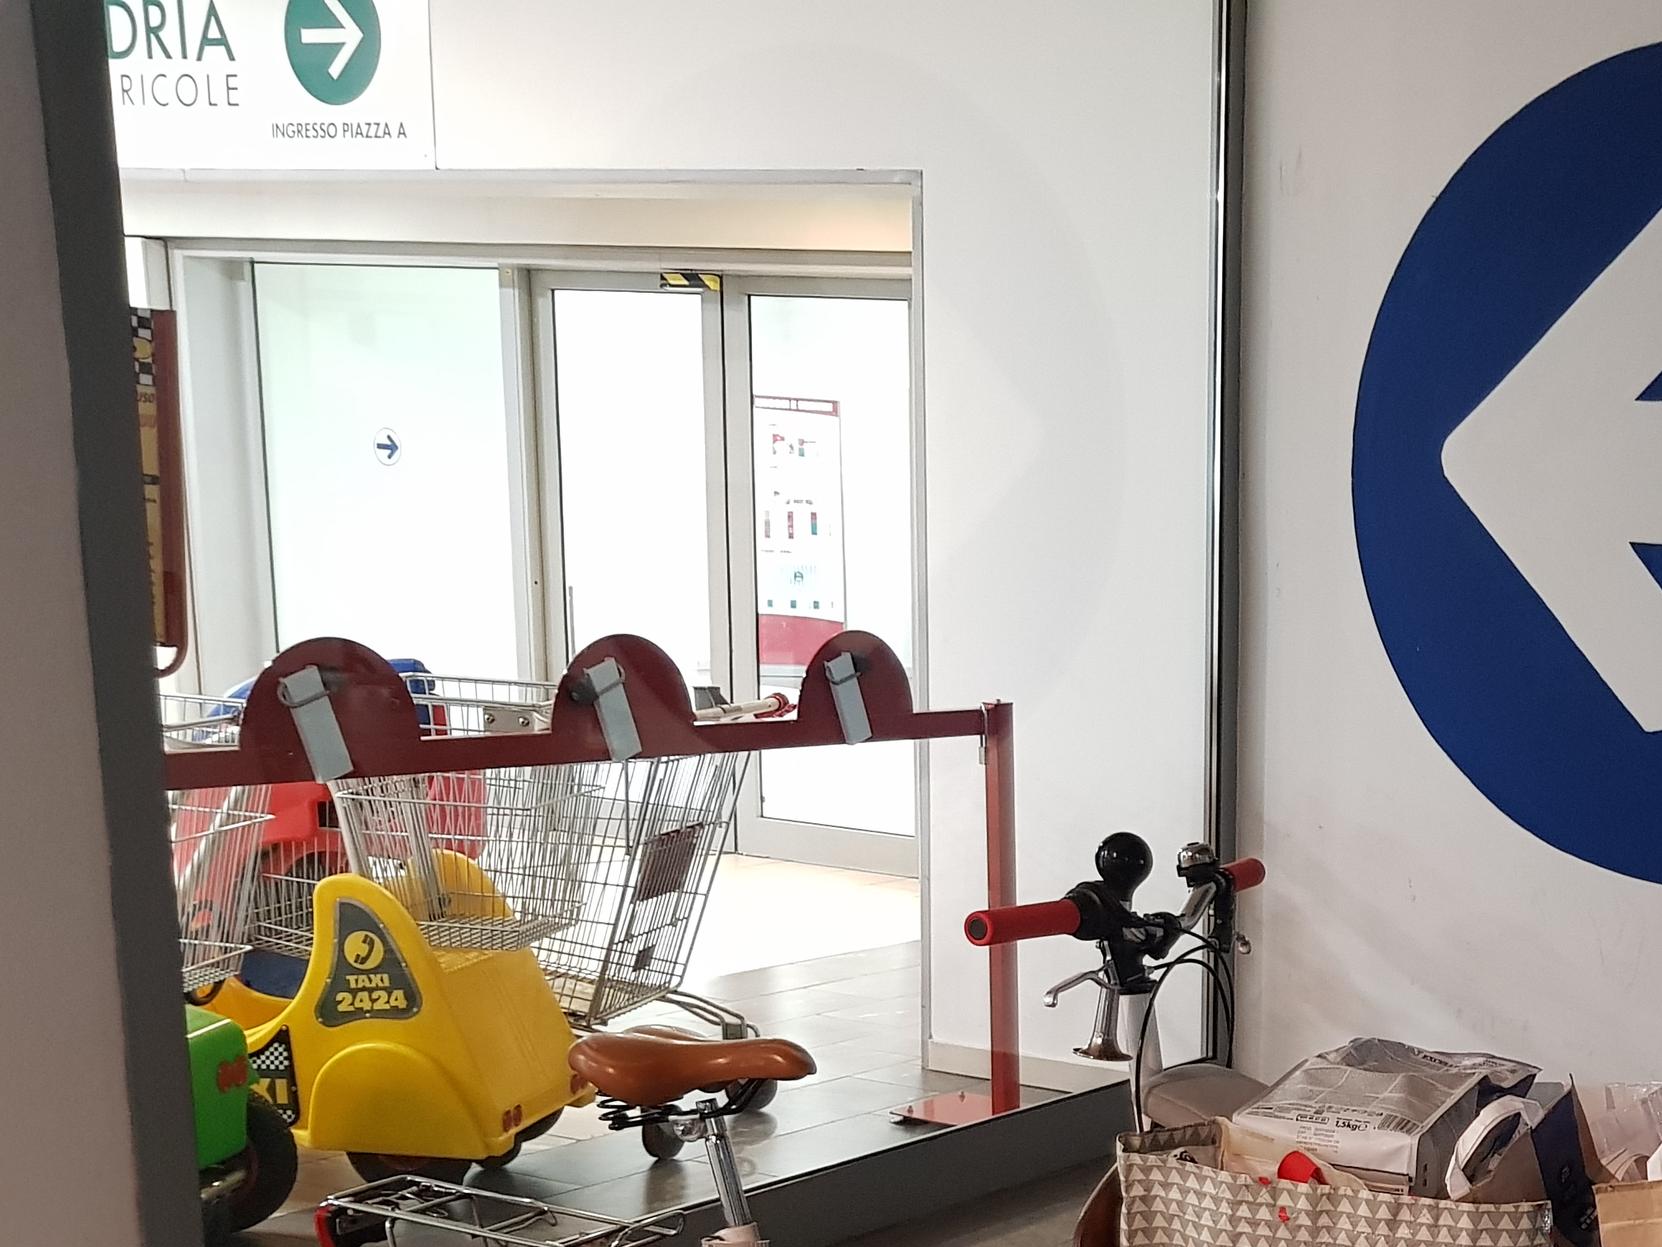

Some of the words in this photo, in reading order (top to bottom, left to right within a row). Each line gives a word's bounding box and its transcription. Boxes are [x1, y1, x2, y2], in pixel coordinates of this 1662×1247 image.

[120, 73, 239, 107] RICOLE
[271, 122, 338, 139] INGRESSO
[341, 122, 393, 139] PIAZZA
[396, 122, 408, 139] A
[345, 973, 391, 989] TAXI
[335, 989, 408, 1012] 2424
